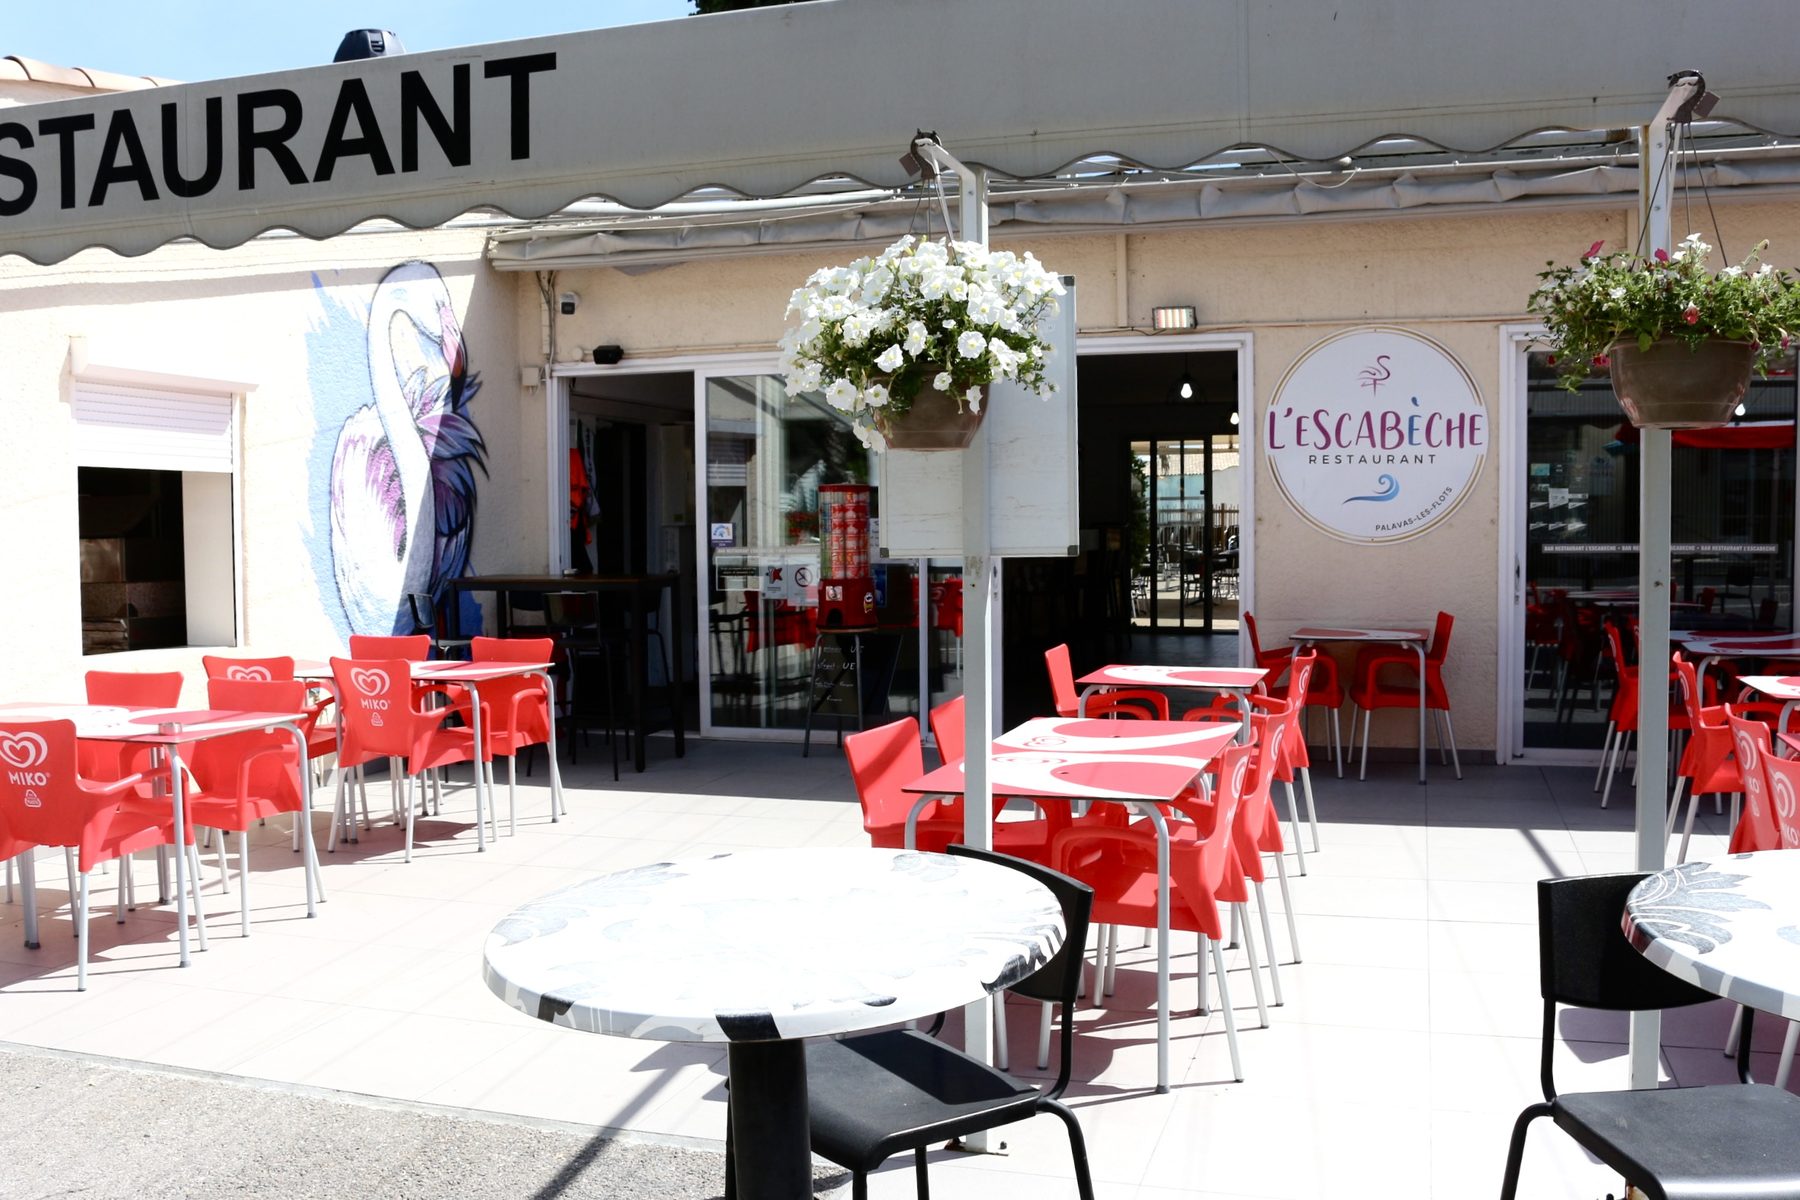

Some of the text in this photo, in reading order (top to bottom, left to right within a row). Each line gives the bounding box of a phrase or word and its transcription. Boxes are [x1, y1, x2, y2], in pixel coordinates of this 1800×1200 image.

[0, 51, 557, 217] STAURANT
[1268, 396, 1484, 451] L'ESCABÈCHE
[1308, 453, 1438, 465] RESTAURANT
[1374, 485, 1454, 532] PALAVAS-LES-FLOTS
[360, 697, 389, 711] MIKO
[8, 770, 48, 787] MIKO
